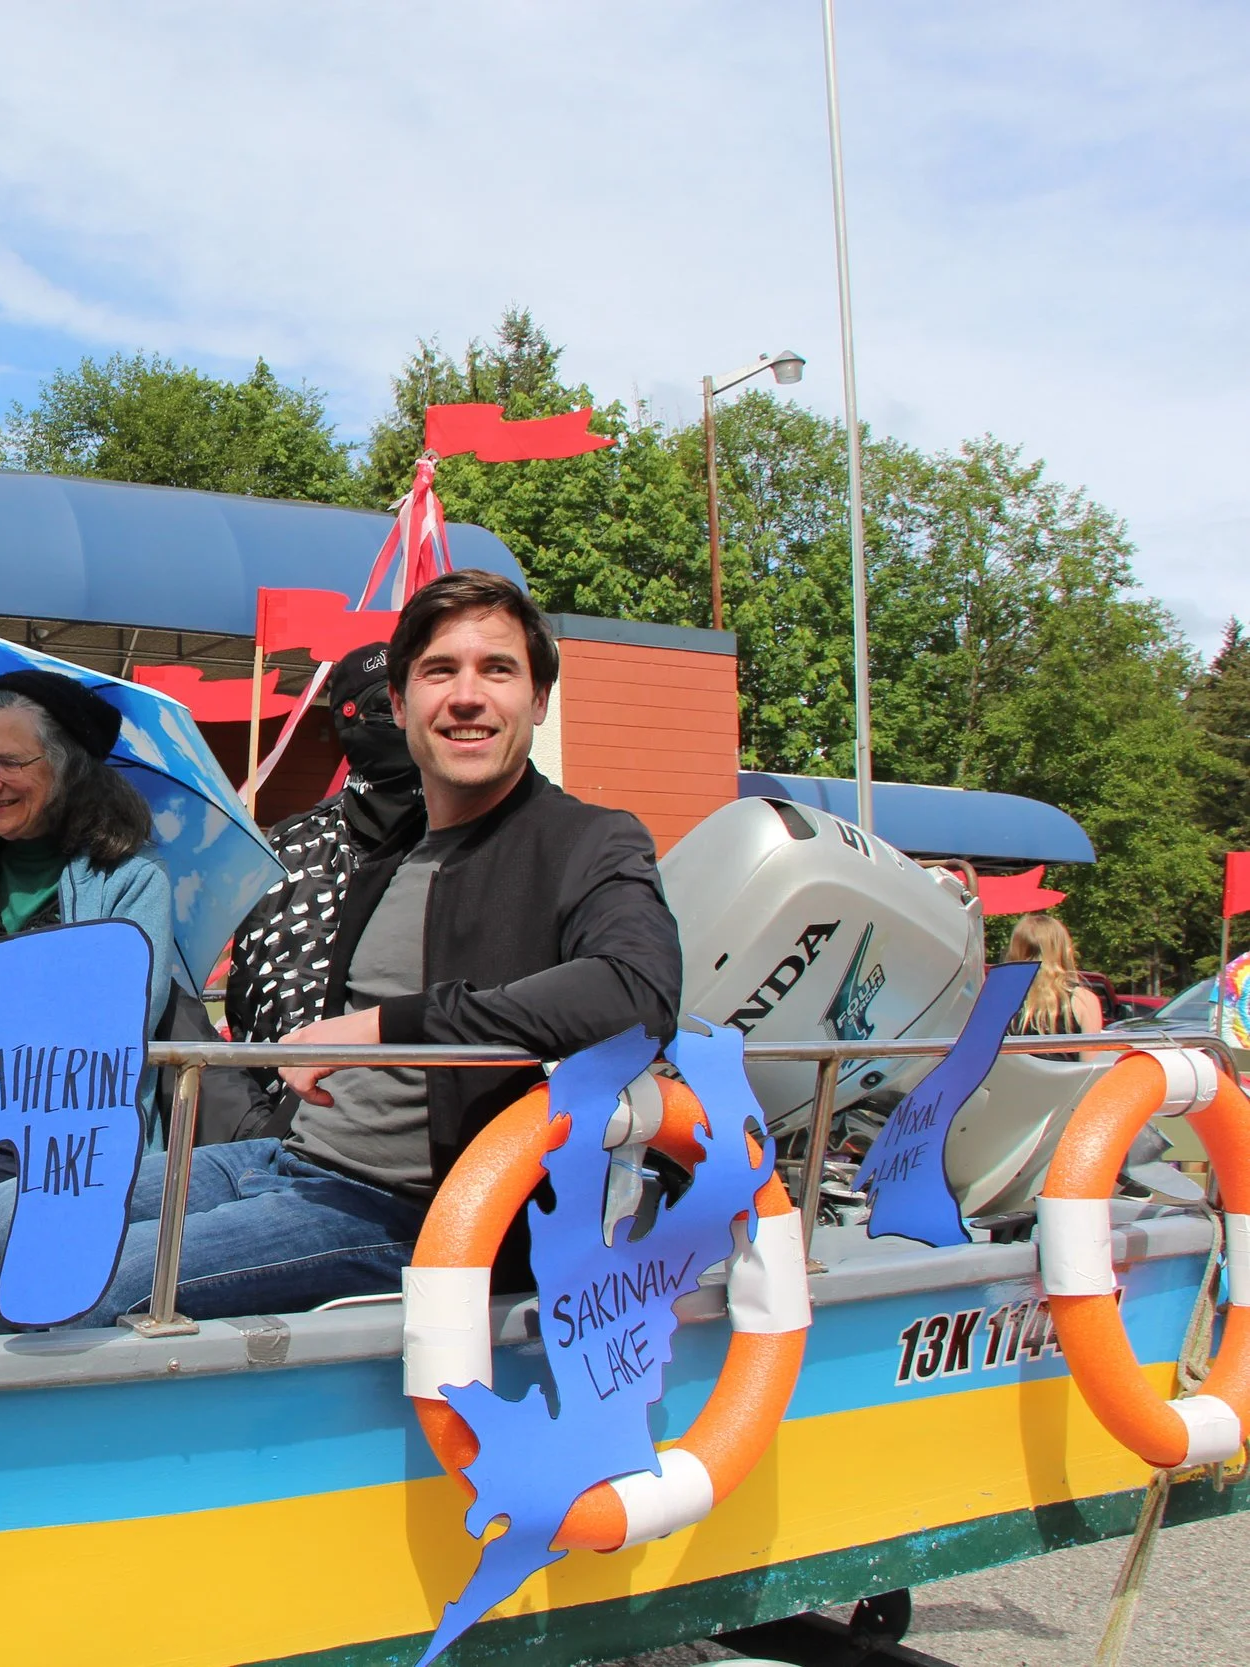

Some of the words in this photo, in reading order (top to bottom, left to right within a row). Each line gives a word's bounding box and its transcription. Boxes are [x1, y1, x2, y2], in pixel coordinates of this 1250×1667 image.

[362, 649, 388, 673] CA
[723, 919, 842, 1036] NDA
[836, 965, 883, 1029] FOUR
[21, 1125, 110, 1197] LAKE
[877, 1141, 929, 1182] LAKE
[552, 1251, 696, 1348] SAKINAW
[582, 1320, 655, 1401] LAKE
[895, 1307, 986, 1386] 13K
